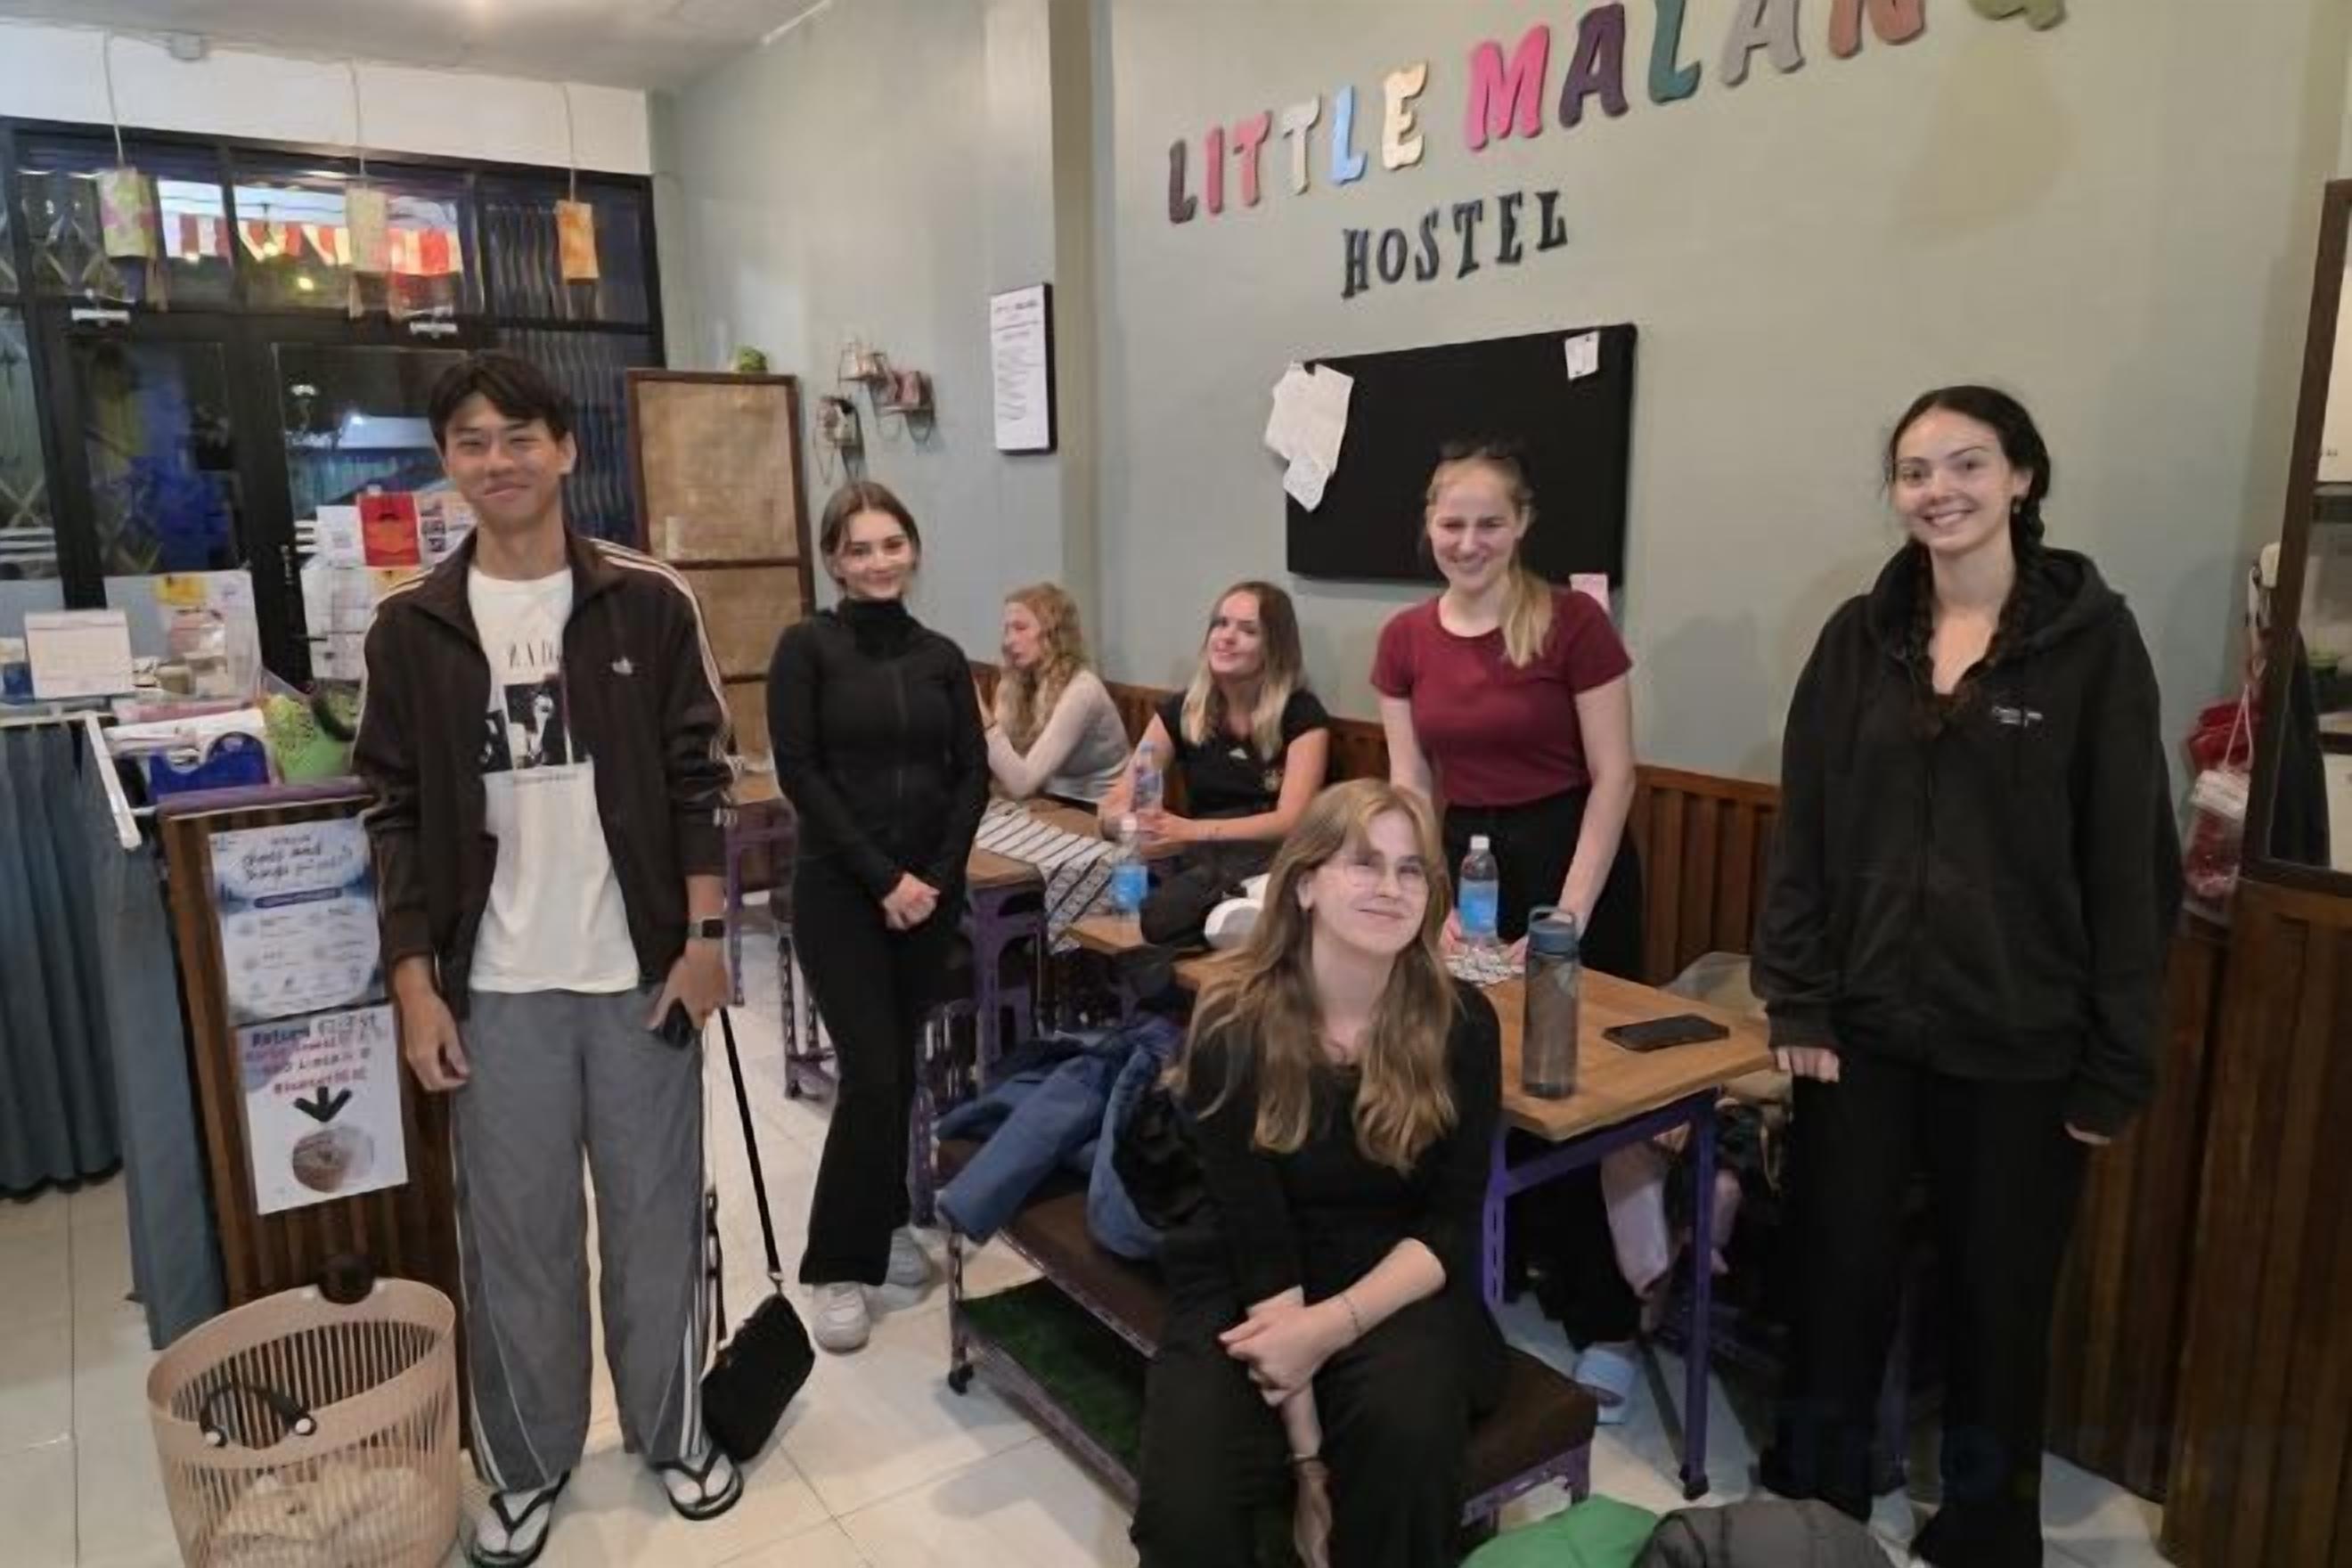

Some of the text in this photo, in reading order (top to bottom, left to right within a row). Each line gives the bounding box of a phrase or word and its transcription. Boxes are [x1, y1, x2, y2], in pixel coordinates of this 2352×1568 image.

[1168, 0, 2067, 225] LITTLE MALA
[1342, 189, 1567, 298] HOSTEL
